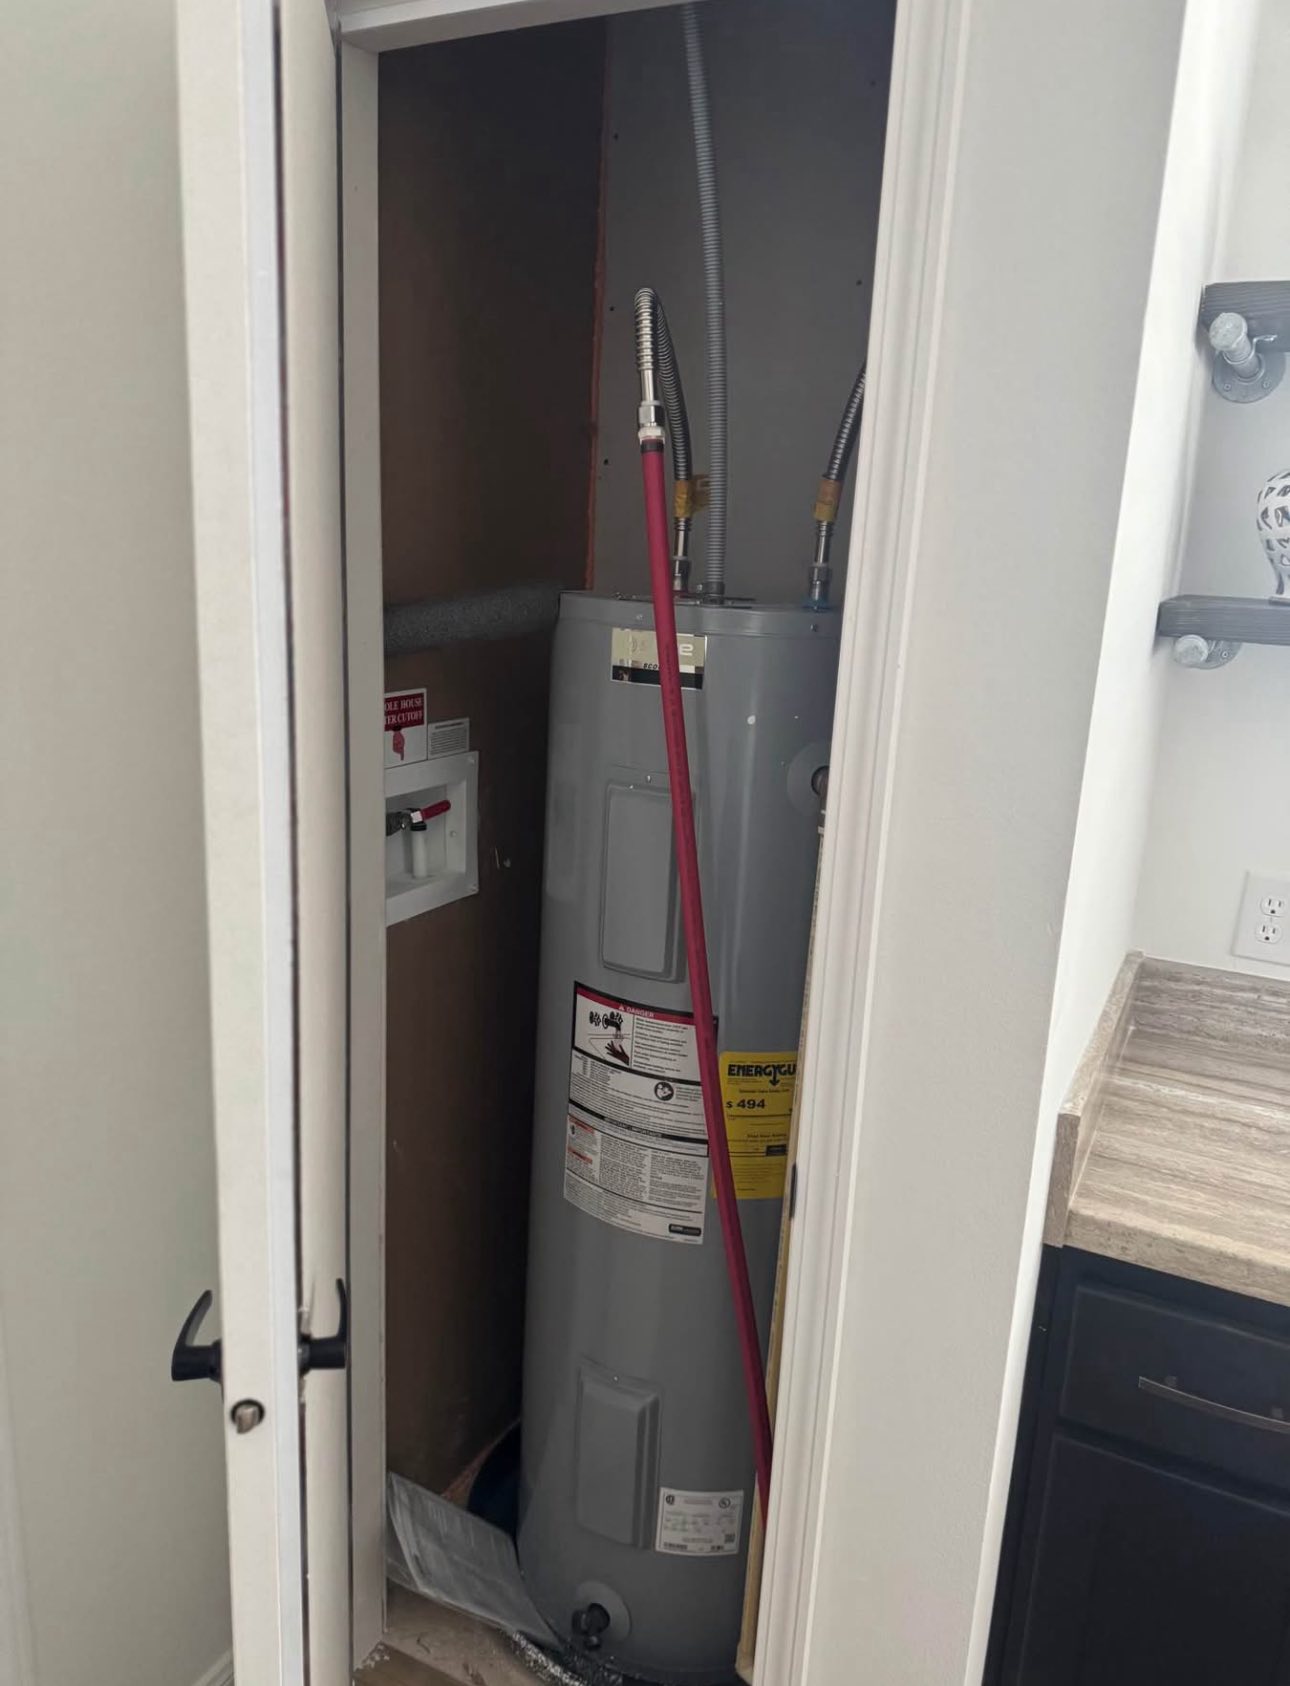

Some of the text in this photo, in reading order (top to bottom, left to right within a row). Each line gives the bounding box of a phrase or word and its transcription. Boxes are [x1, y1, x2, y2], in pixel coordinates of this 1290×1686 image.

[401, 698, 421, 709] HOUSE
[398, 711, 422, 722] CUTOFF
[626, 1006, 655, 1018] DANGER
[736, 1099, 766, 1109] 494
